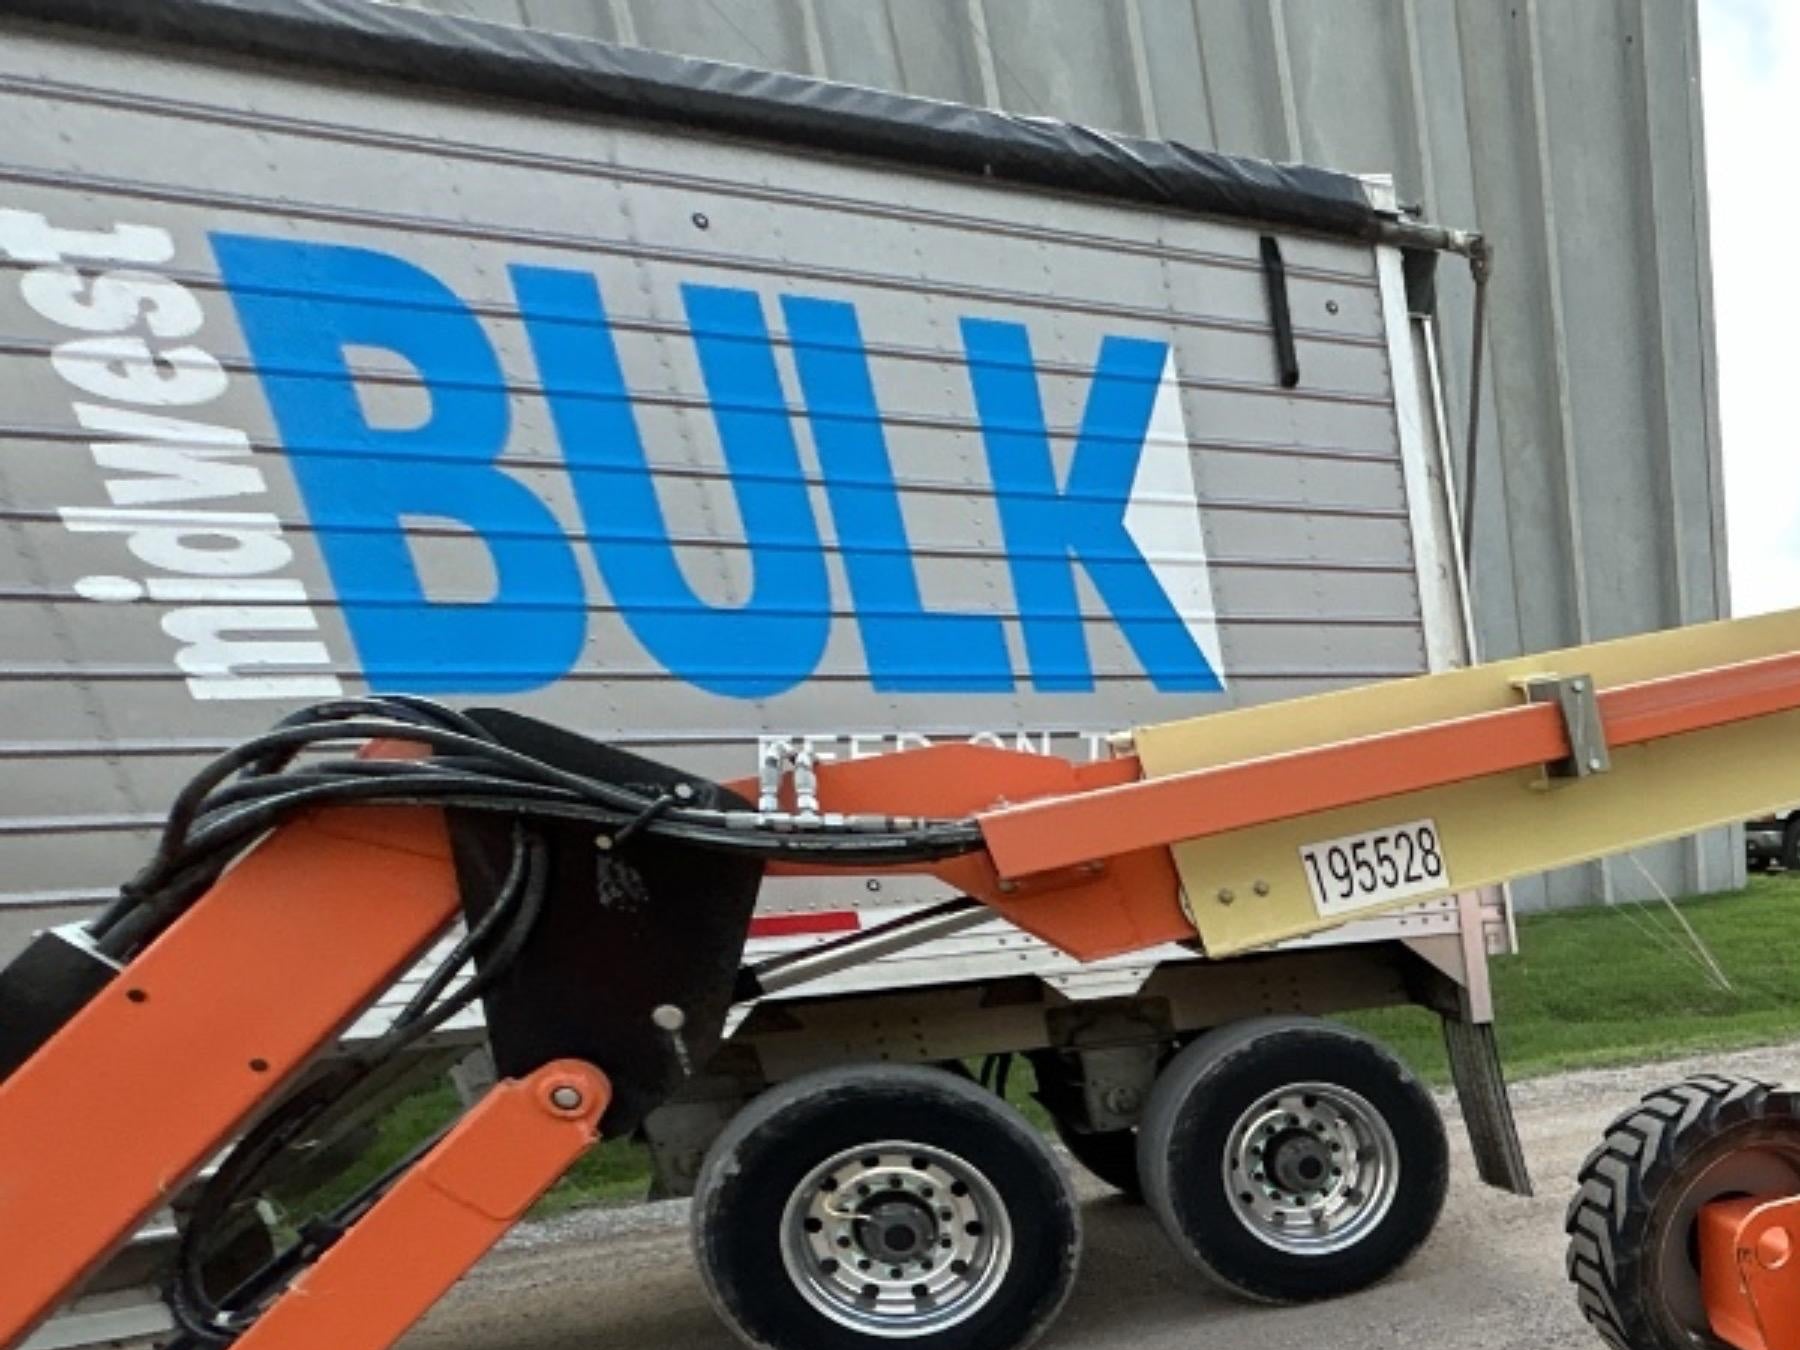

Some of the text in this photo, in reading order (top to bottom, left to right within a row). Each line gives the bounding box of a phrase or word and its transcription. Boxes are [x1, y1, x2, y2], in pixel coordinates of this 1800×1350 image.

[0, 209, 344, 700] midwest
[207, 231, 1228, 699] BULK
[1304, 827, 1441, 904] 195528
